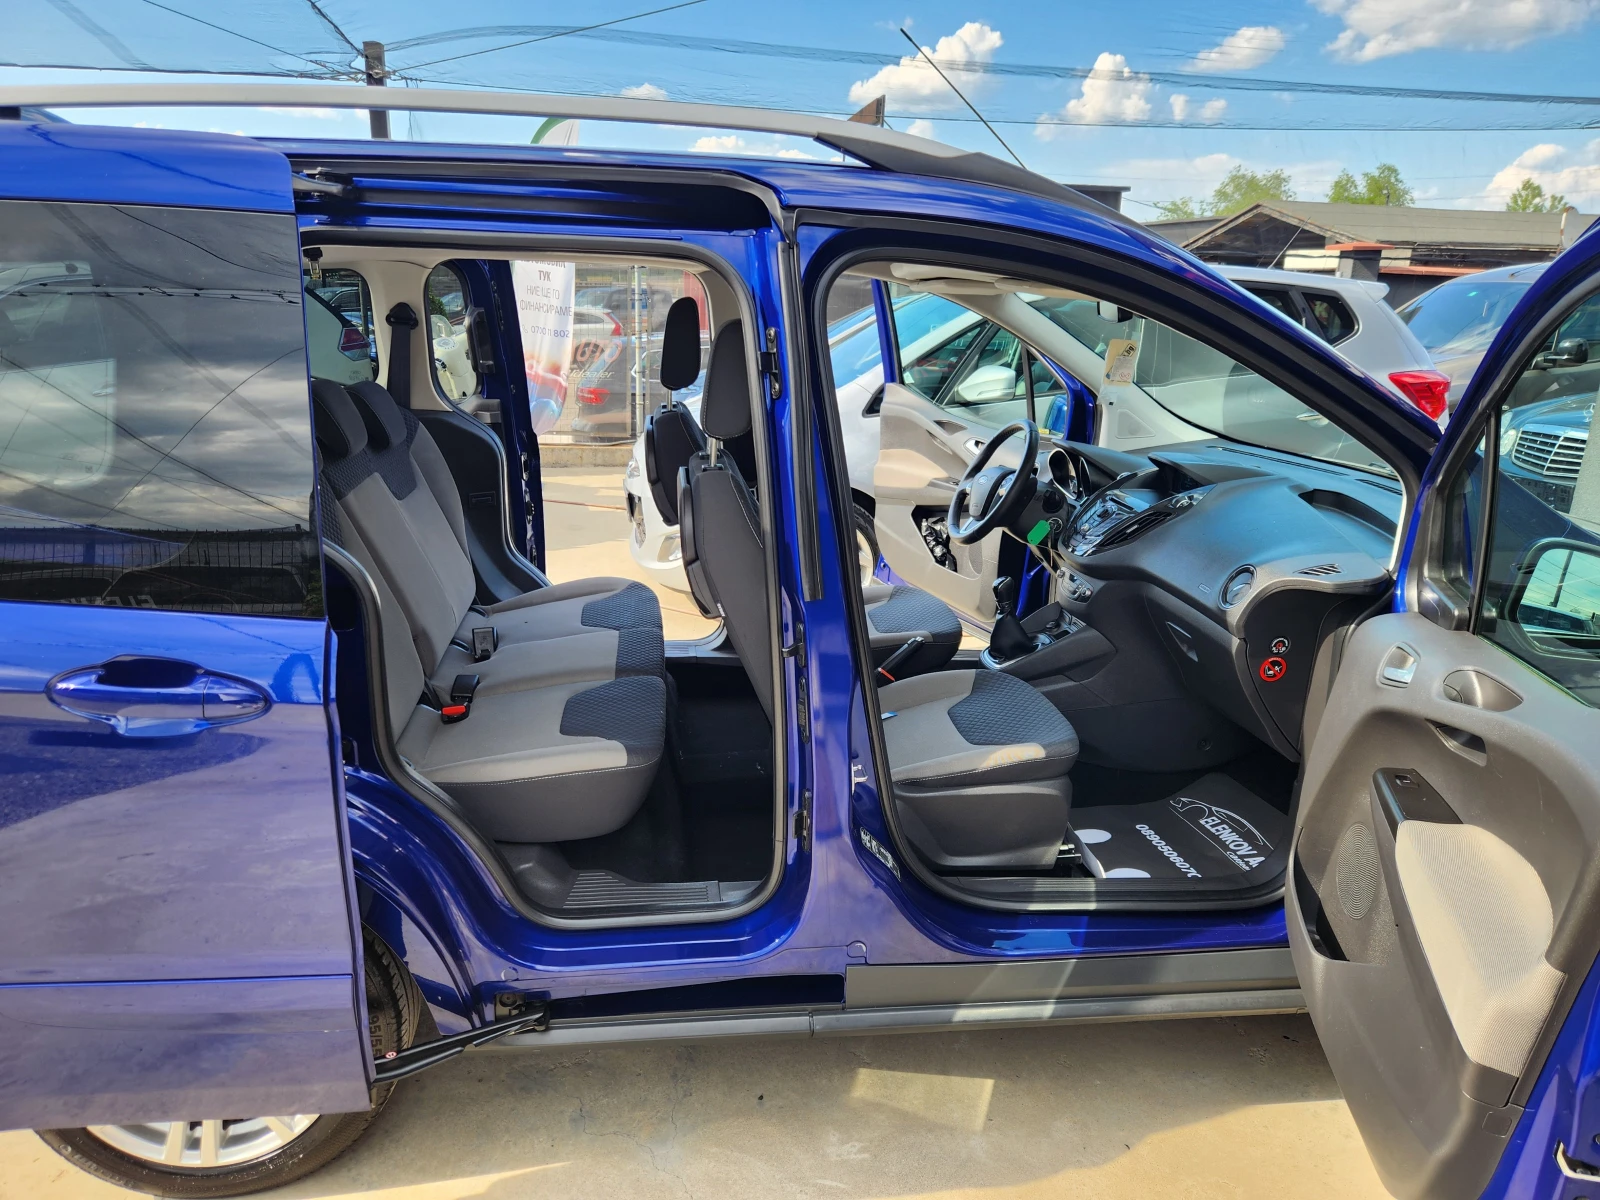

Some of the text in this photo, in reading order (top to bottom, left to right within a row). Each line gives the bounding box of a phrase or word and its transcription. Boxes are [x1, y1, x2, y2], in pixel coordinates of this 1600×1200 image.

[538, 270, 551, 282] ТУК
[527, 285, 540, 296] НИЕ
[554, 330, 570, 338] 802
[1199, 816, 1257, 856] ELENKOV
